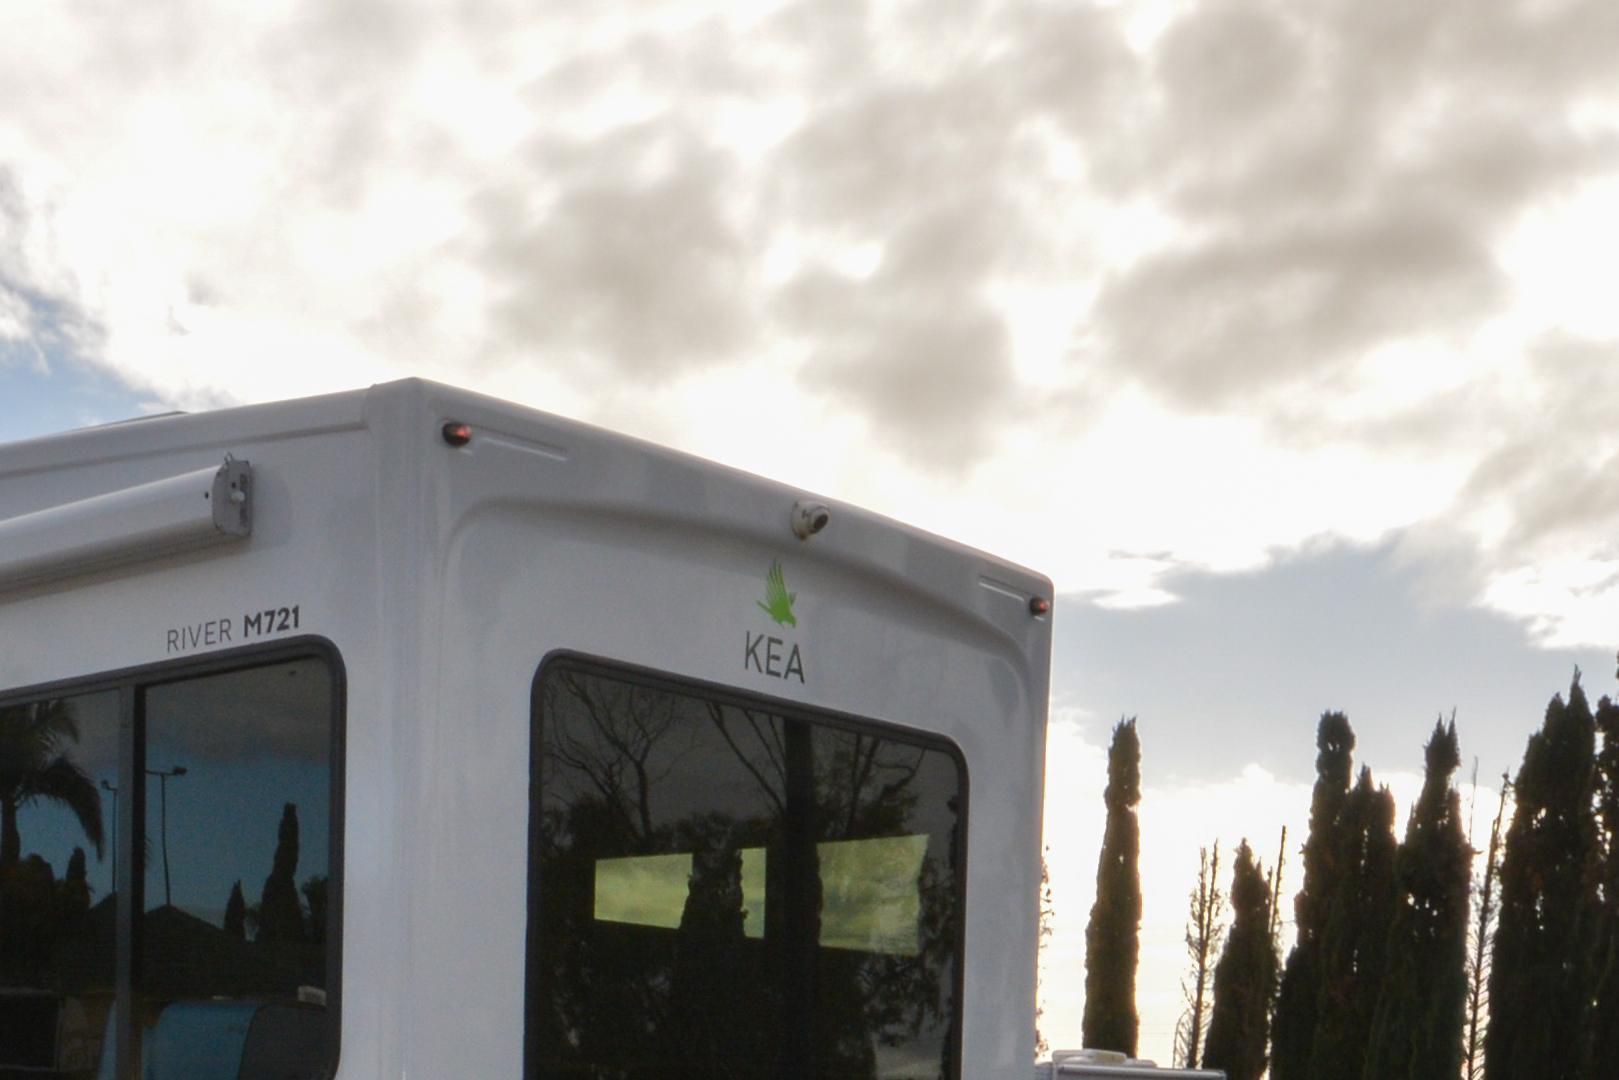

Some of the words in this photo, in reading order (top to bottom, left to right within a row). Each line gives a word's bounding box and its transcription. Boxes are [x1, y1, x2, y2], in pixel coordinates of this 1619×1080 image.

[167, 619, 231, 652] RIVER
[243, 605, 300, 637] M721
[744, 630, 805, 684] KEA
